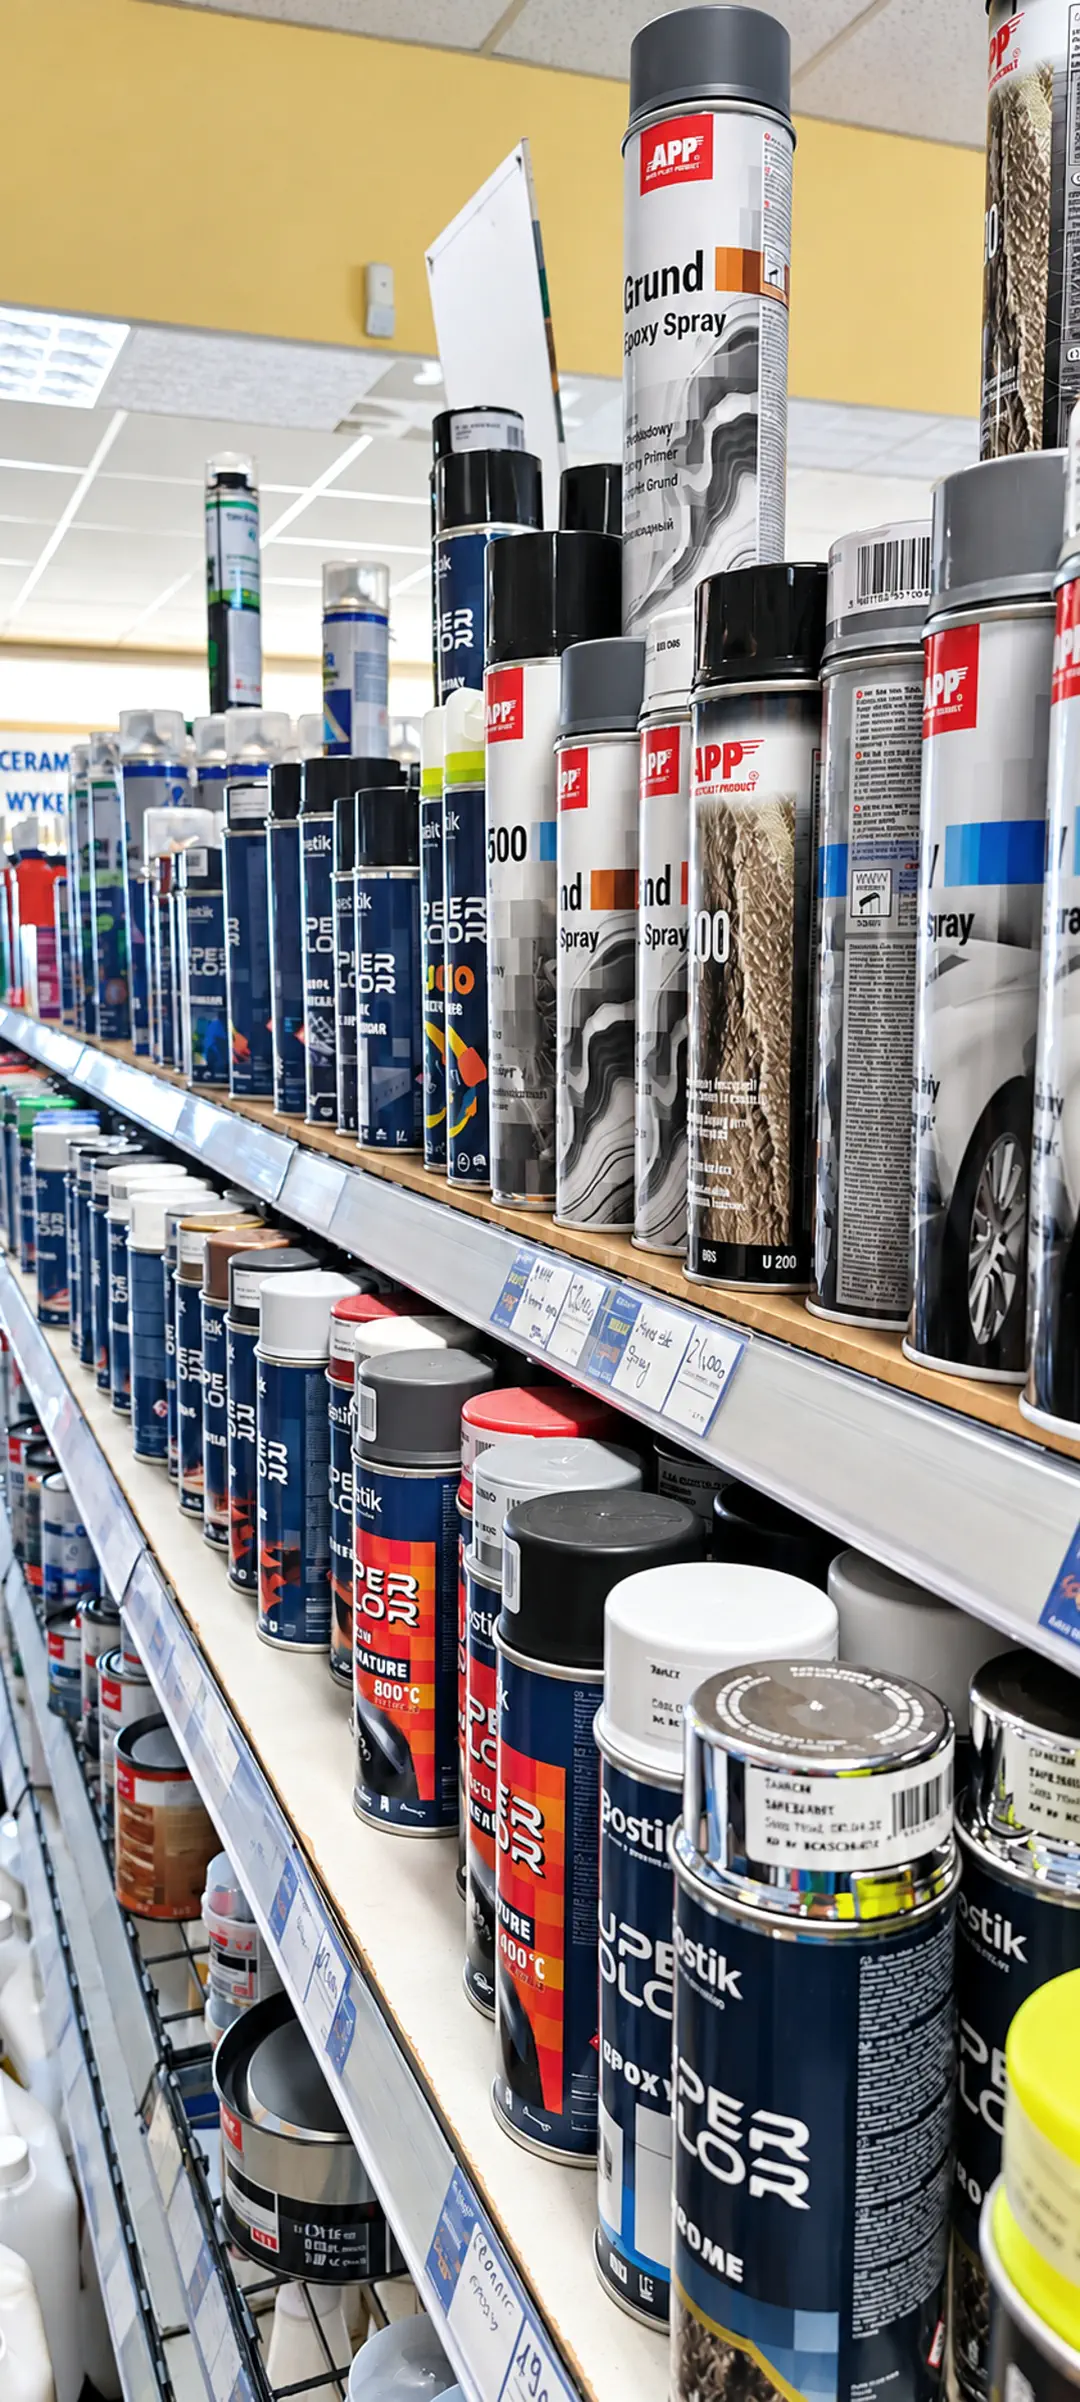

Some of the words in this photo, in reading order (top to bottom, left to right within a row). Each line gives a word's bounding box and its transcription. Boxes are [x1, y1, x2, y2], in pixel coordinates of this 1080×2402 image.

[648, 137, 703, 171] APP
[624, 249, 704, 314] Grund
[663, 312, 727, 341] Spray
[644, 448, 679, 465] Primer
[646, 474, 679, 493] Grund
[644, 922, 690, 952] Spray
[762, 1254, 772, 1269] U
[775, 1255, 797, 1269] 200
[373, 1679, 421, 1704] 800°C
